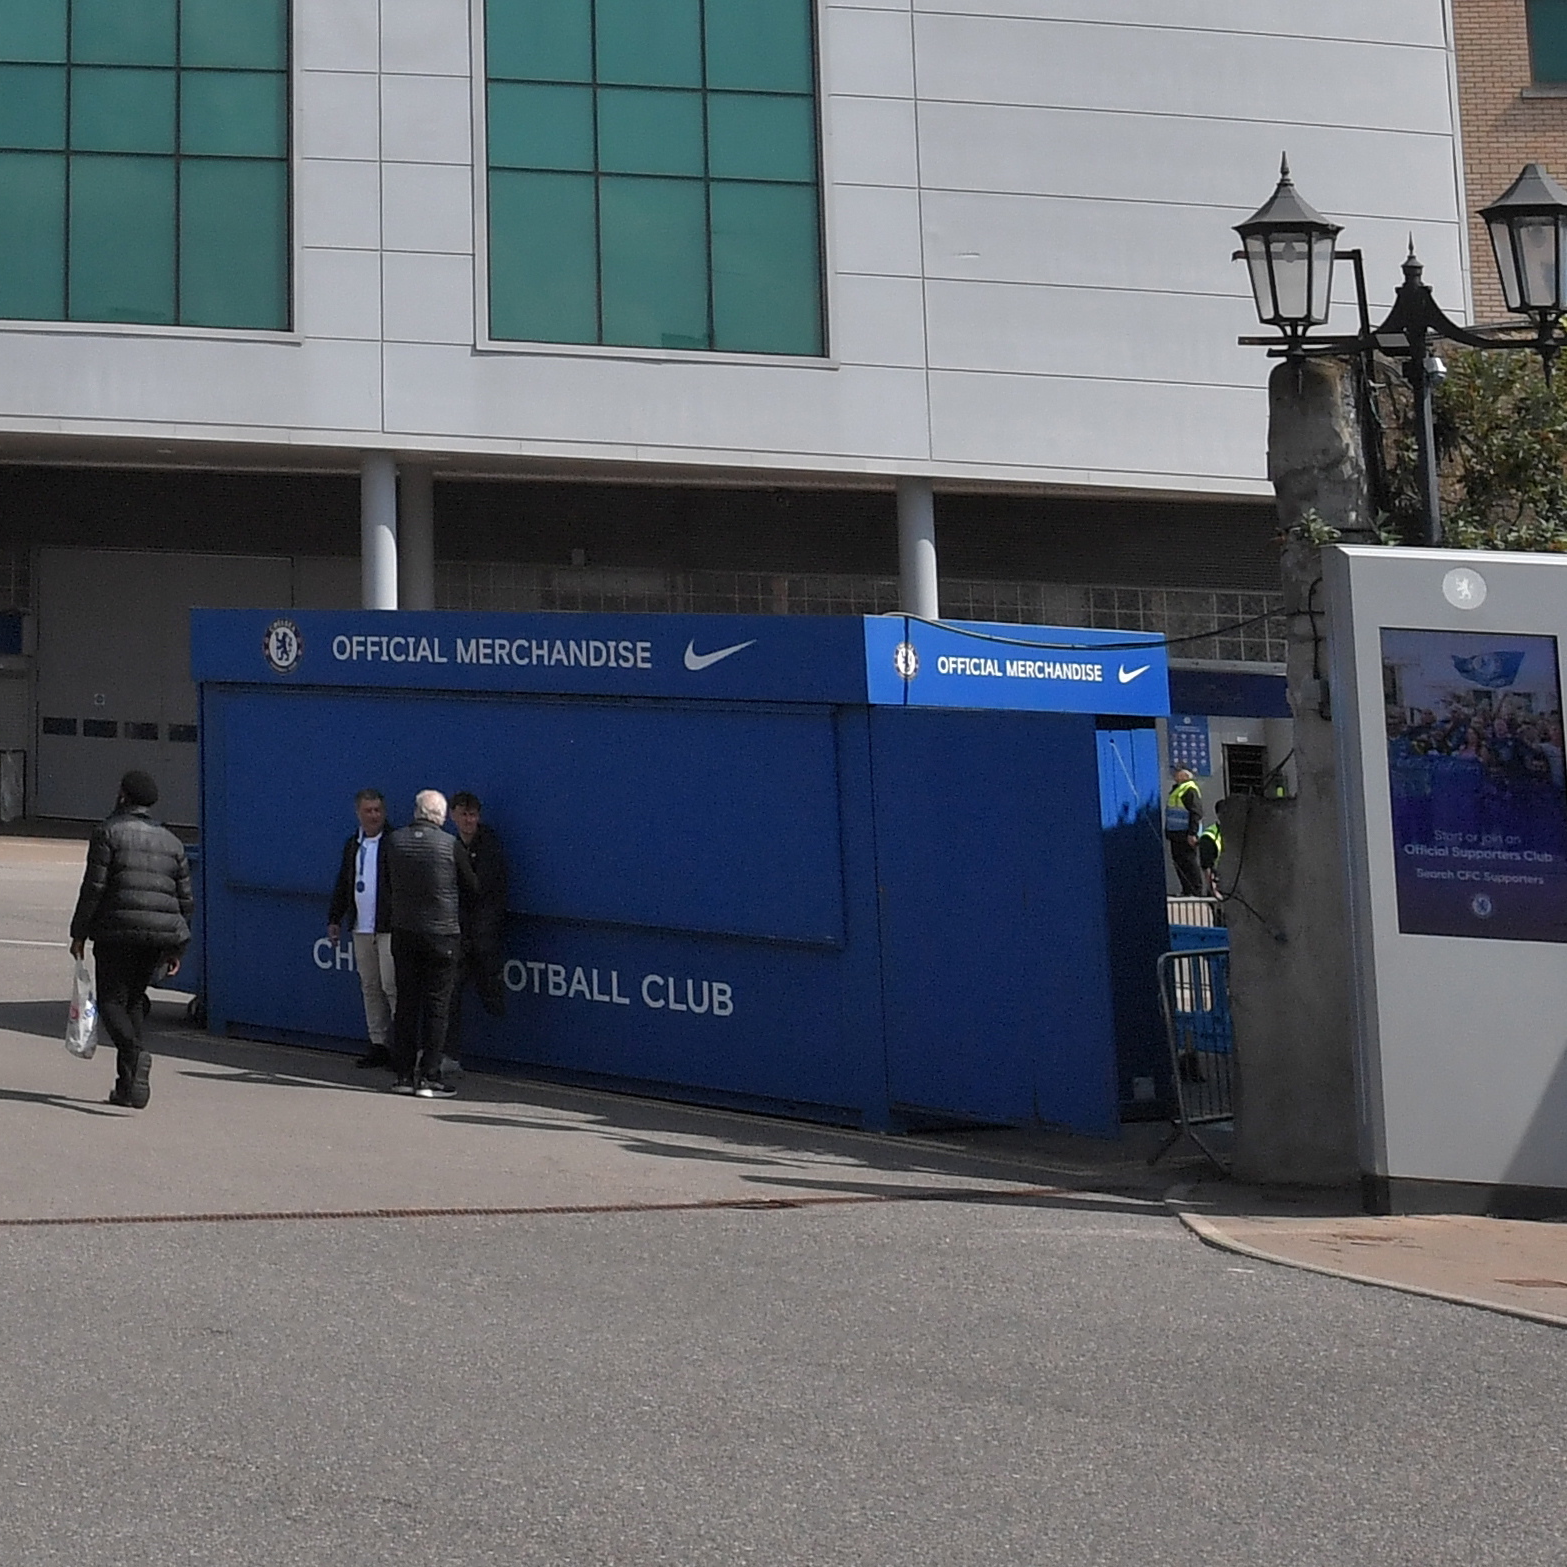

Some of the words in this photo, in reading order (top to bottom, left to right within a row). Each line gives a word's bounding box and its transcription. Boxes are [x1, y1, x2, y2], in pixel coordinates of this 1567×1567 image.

[332, 635, 447, 664] OFFICIAL
[455, 638, 653, 669] MERCHANDISE
[937, 656, 1003, 677] OFFICIAL
[1006, 659, 1103, 682] MERCHANDISE
[1434, 829, 1463, 842] Start
[1465, 832, 1478, 842] or
[1480, 832, 1504, 846] join
[1505, 834, 1522, 844] an
[1404, 843, 1449, 857] Official
[1452, 846, 1522, 861] Supporters
[1523, 850, 1553, 863] Club
[1416, 867, 1455, 879] Search
[1457, 870, 1481, 881] CFC
[1483, 871, 1544, 884] Supporters
[503, 959, 631, 1006] OTBALL
[641, 974, 734, 1017] CLUB
